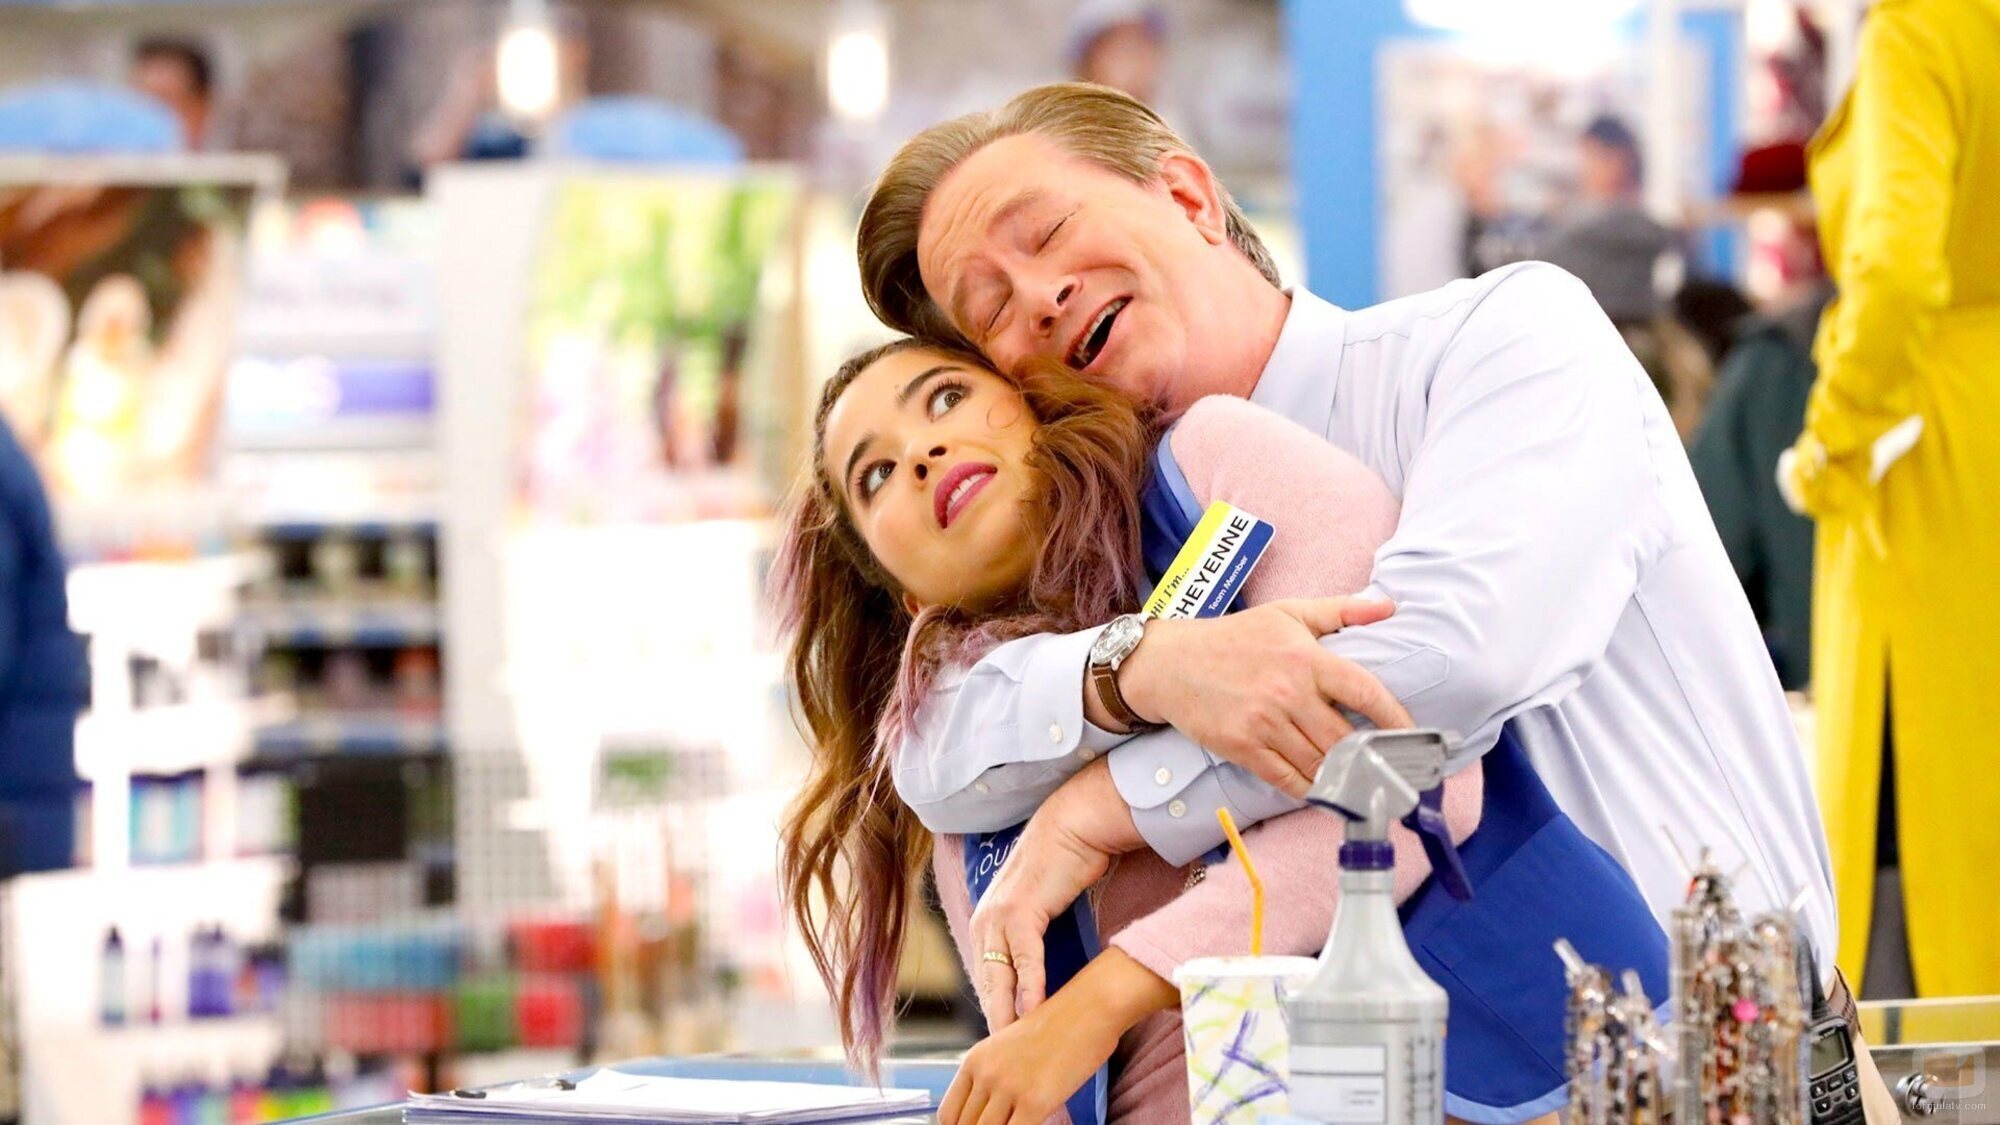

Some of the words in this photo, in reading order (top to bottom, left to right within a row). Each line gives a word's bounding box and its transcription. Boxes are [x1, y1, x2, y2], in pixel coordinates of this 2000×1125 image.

[1208, 589, 1226, 611] Team
[1224, 555, 1249, 590] Member
[1150, 598, 1167, 619] Hi!
